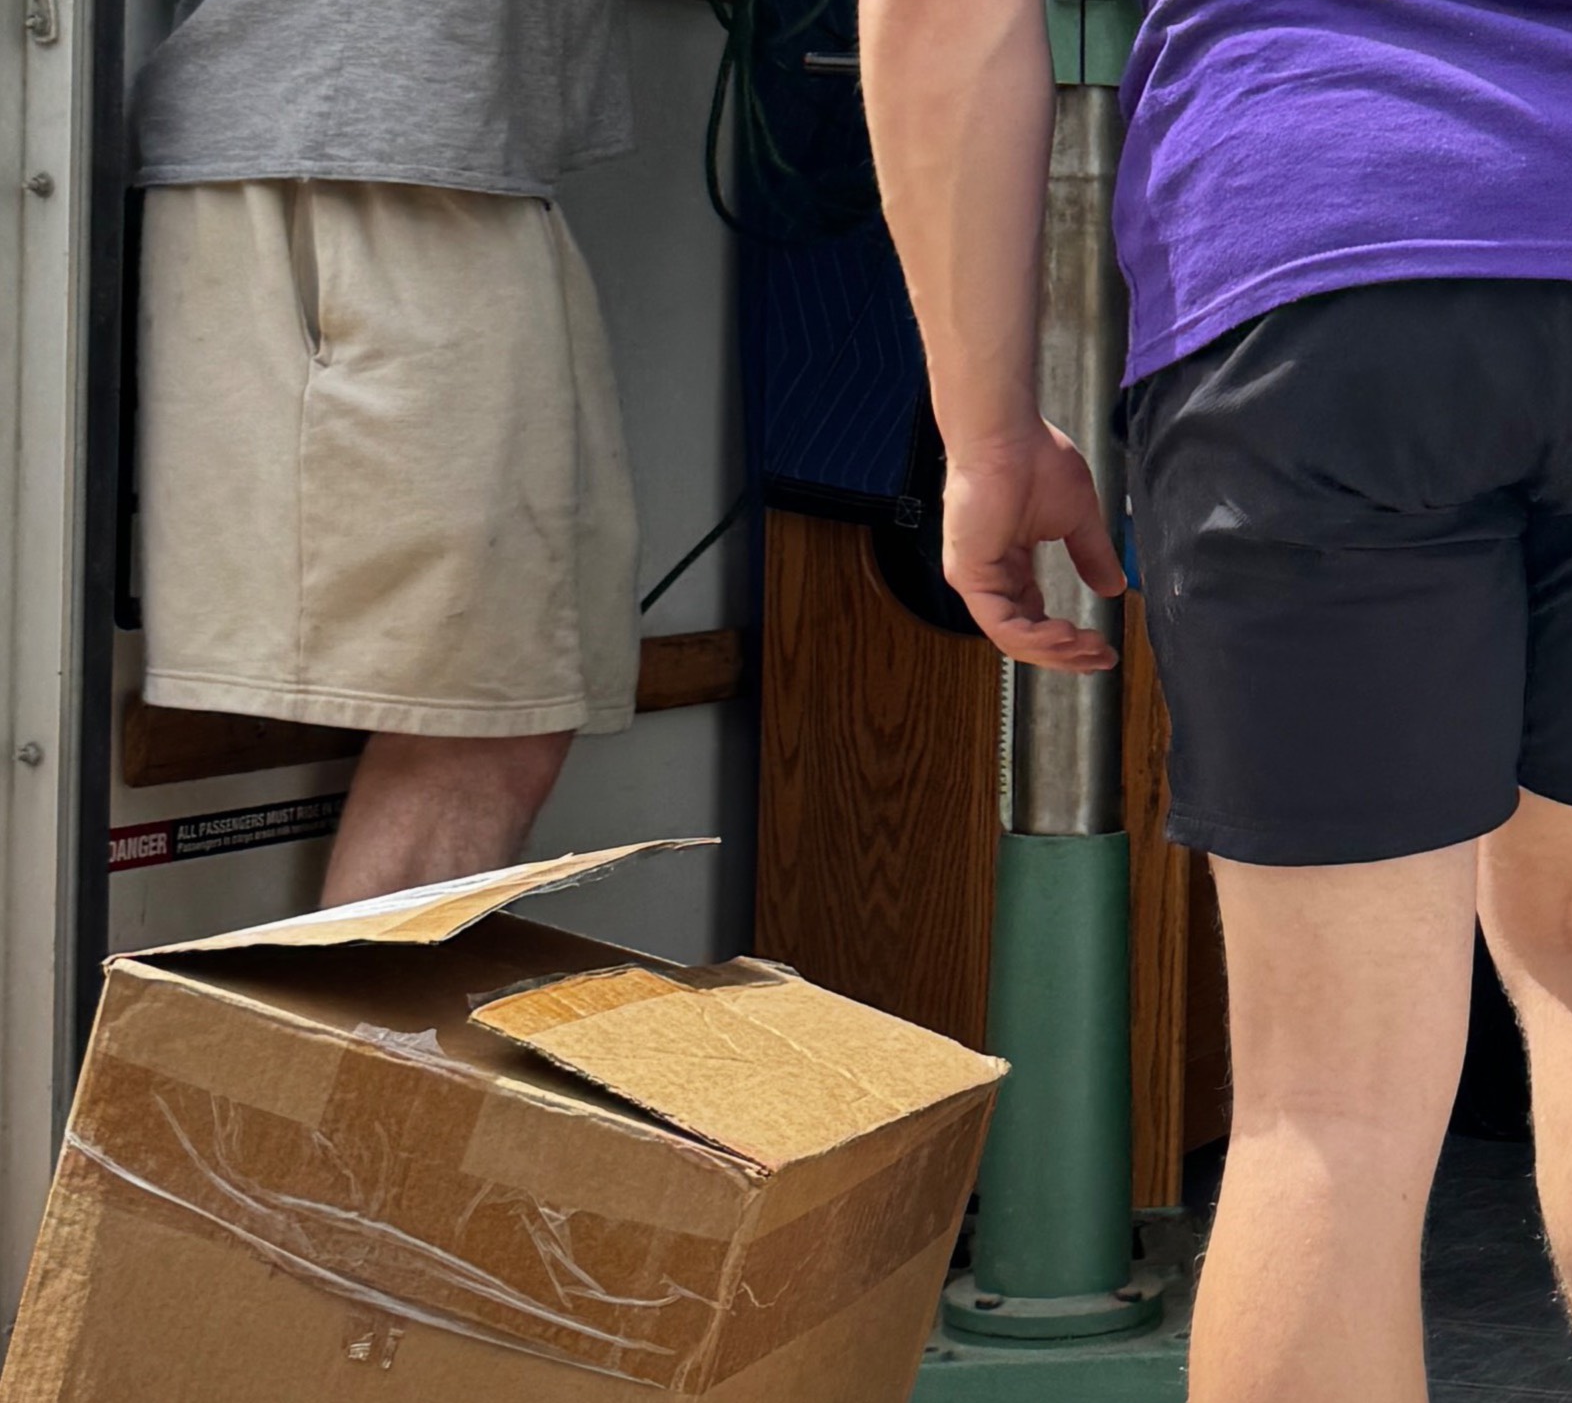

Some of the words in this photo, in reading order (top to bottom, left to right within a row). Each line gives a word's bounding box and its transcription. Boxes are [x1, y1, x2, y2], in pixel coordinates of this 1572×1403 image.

[177, 824, 197, 840] ALL
[199, 813, 264, 837] PASSENGERS
[266, 807, 295, 827] MUST
